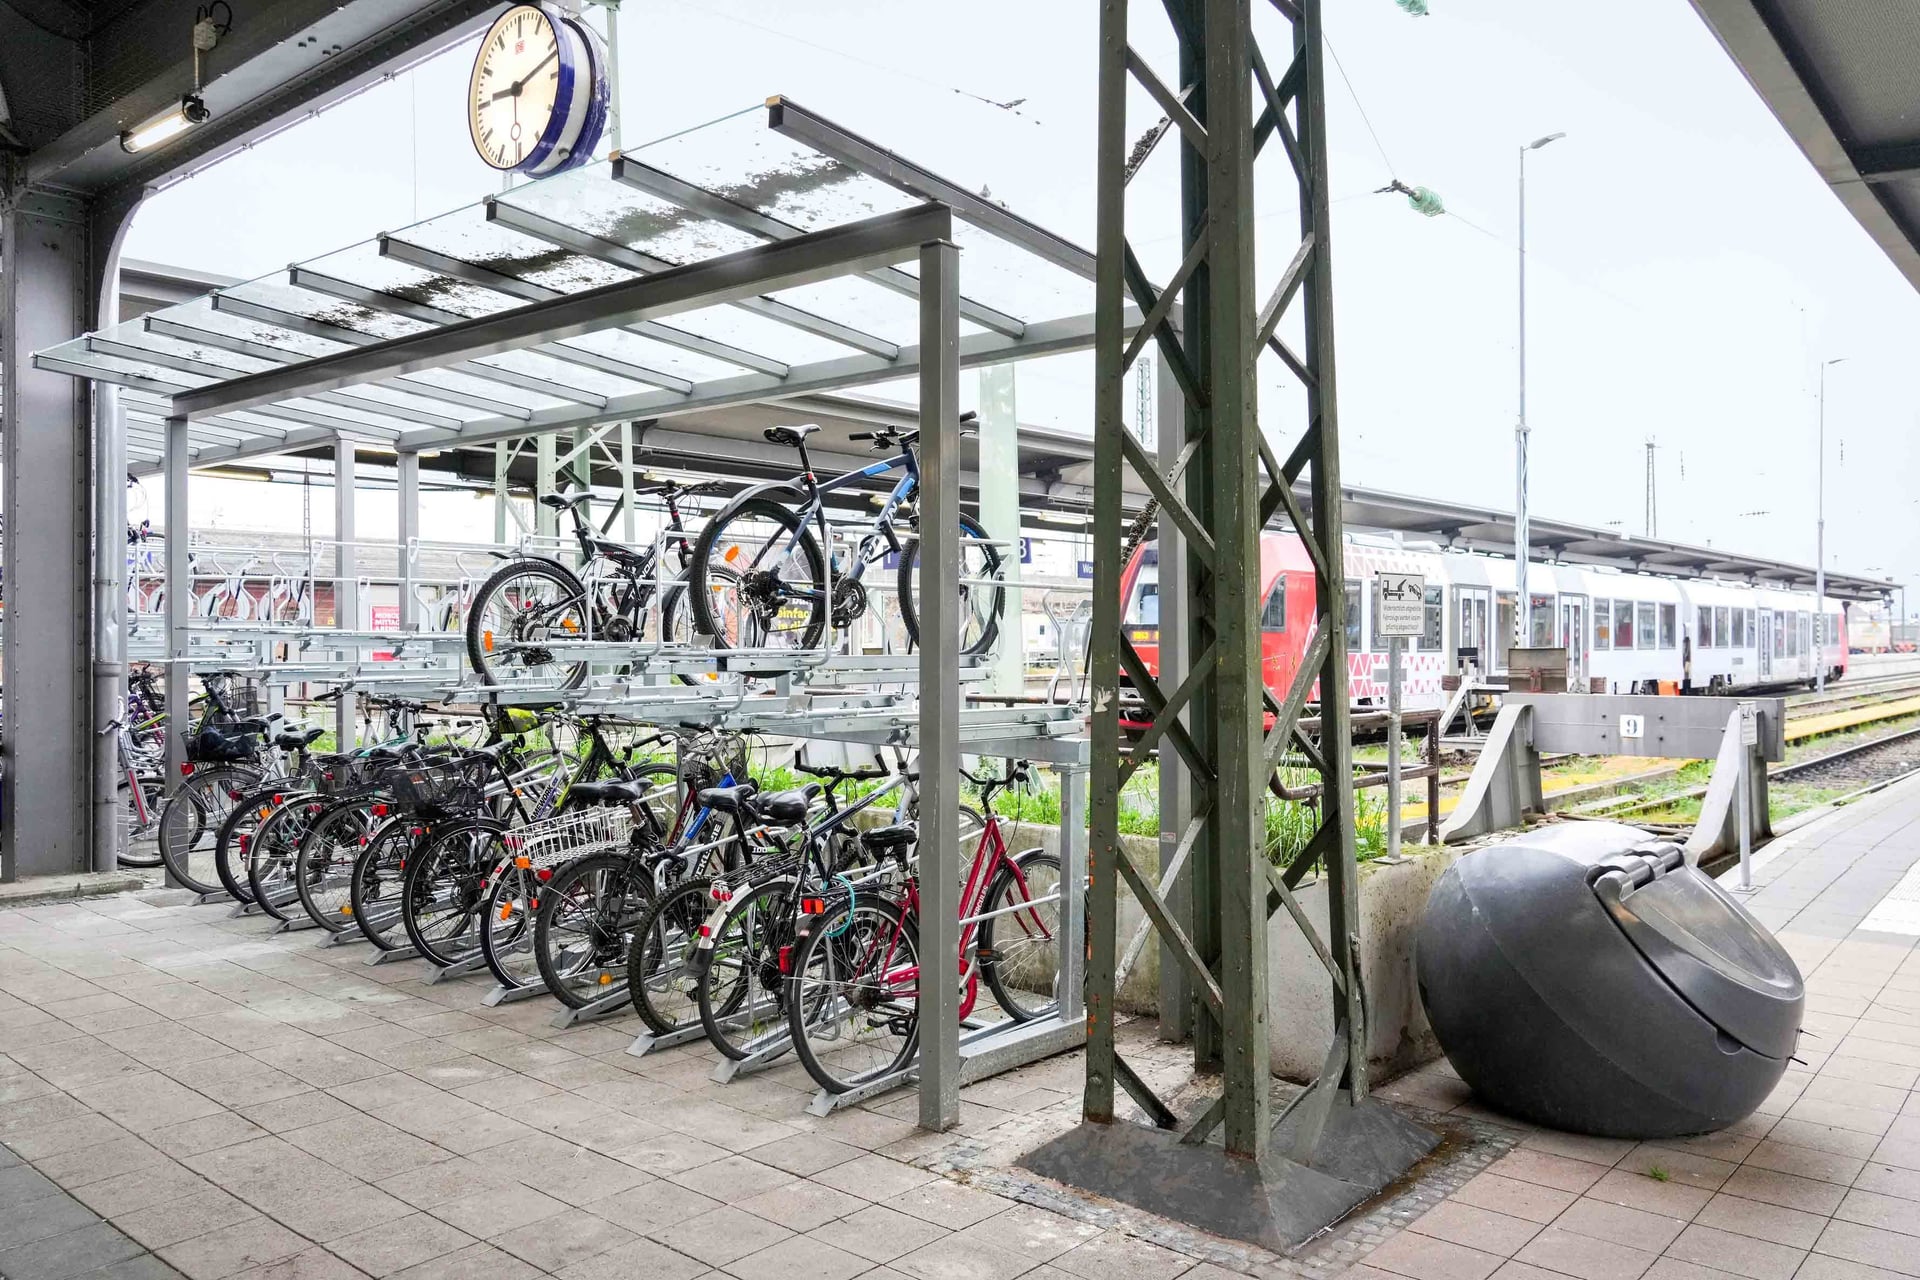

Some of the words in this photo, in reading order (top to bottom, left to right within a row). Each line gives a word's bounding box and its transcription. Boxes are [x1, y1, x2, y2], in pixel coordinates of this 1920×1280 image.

[778, 606, 809, 619] einfac
[1626, 719, 1638, 735] 9
[973, 884, 988, 917] ERCULES
